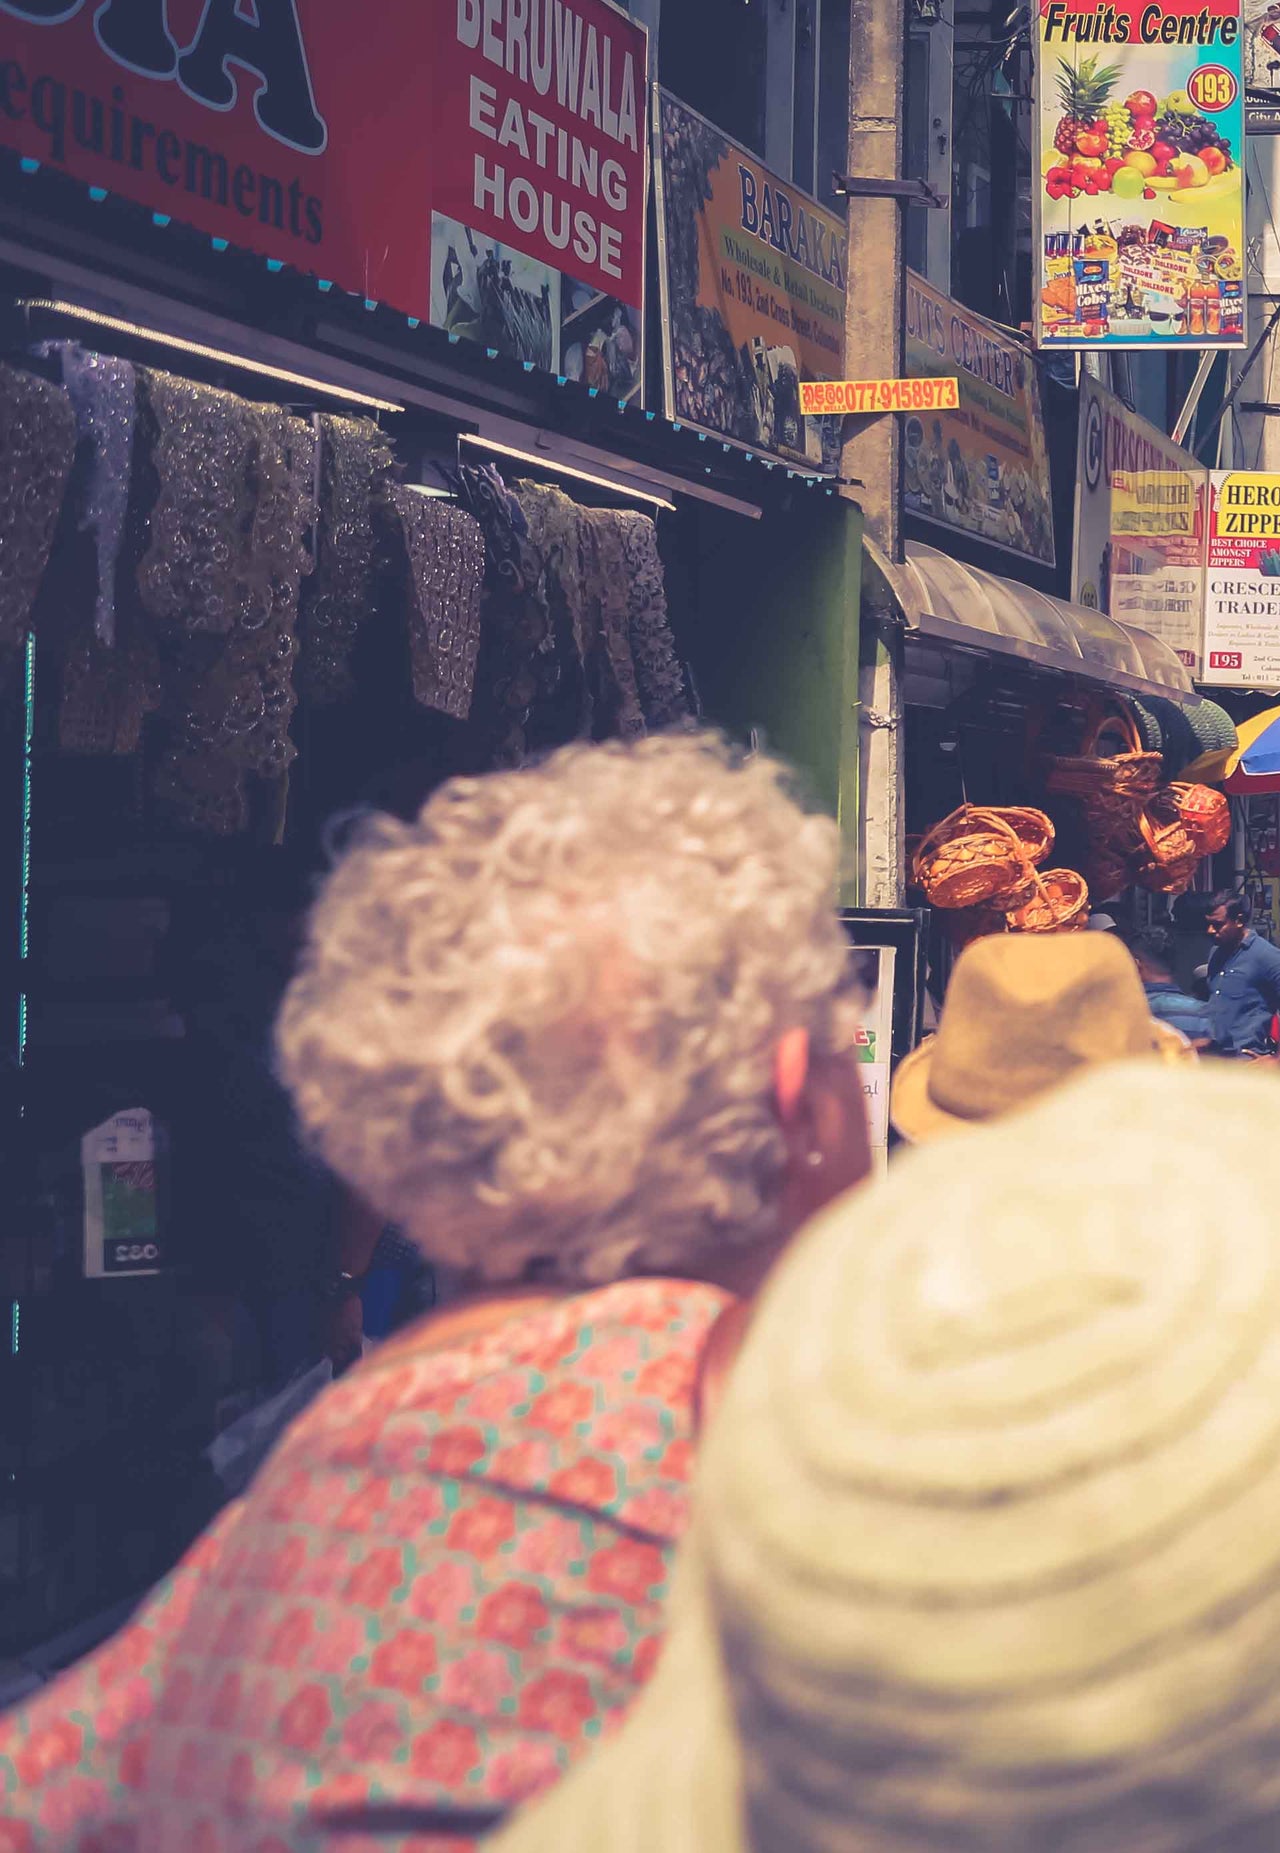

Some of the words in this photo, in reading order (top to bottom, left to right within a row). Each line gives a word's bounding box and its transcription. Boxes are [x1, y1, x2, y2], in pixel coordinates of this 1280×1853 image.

[1043, 3, 1132, 43] Fruits
[1140, 4, 1239, 45] Centre
[1194, 74, 1230, 103] 193
[0, 60, 324, 245] equirements
[469, 75, 627, 211] EATING
[474, 153, 622, 279] HOUSE
[724, 235, 771, 281] Wholesale
[773, 266, 781, 288] &
[721, 268, 734, 297] No.
[1077, 294, 1107, 306] Cobs
[950, 314, 1017, 400] CENTER
[845, 380, 958, 411] 077-9158973
[1210, 549, 1251, 557] AMONGST
[1211, 539, 1233, 547] BEST
[1234, 540, 1268, 549] CHOICE
[1210, 558, 1245, 567] ZIPPERS
[1213, 654, 1239, 667] 195
